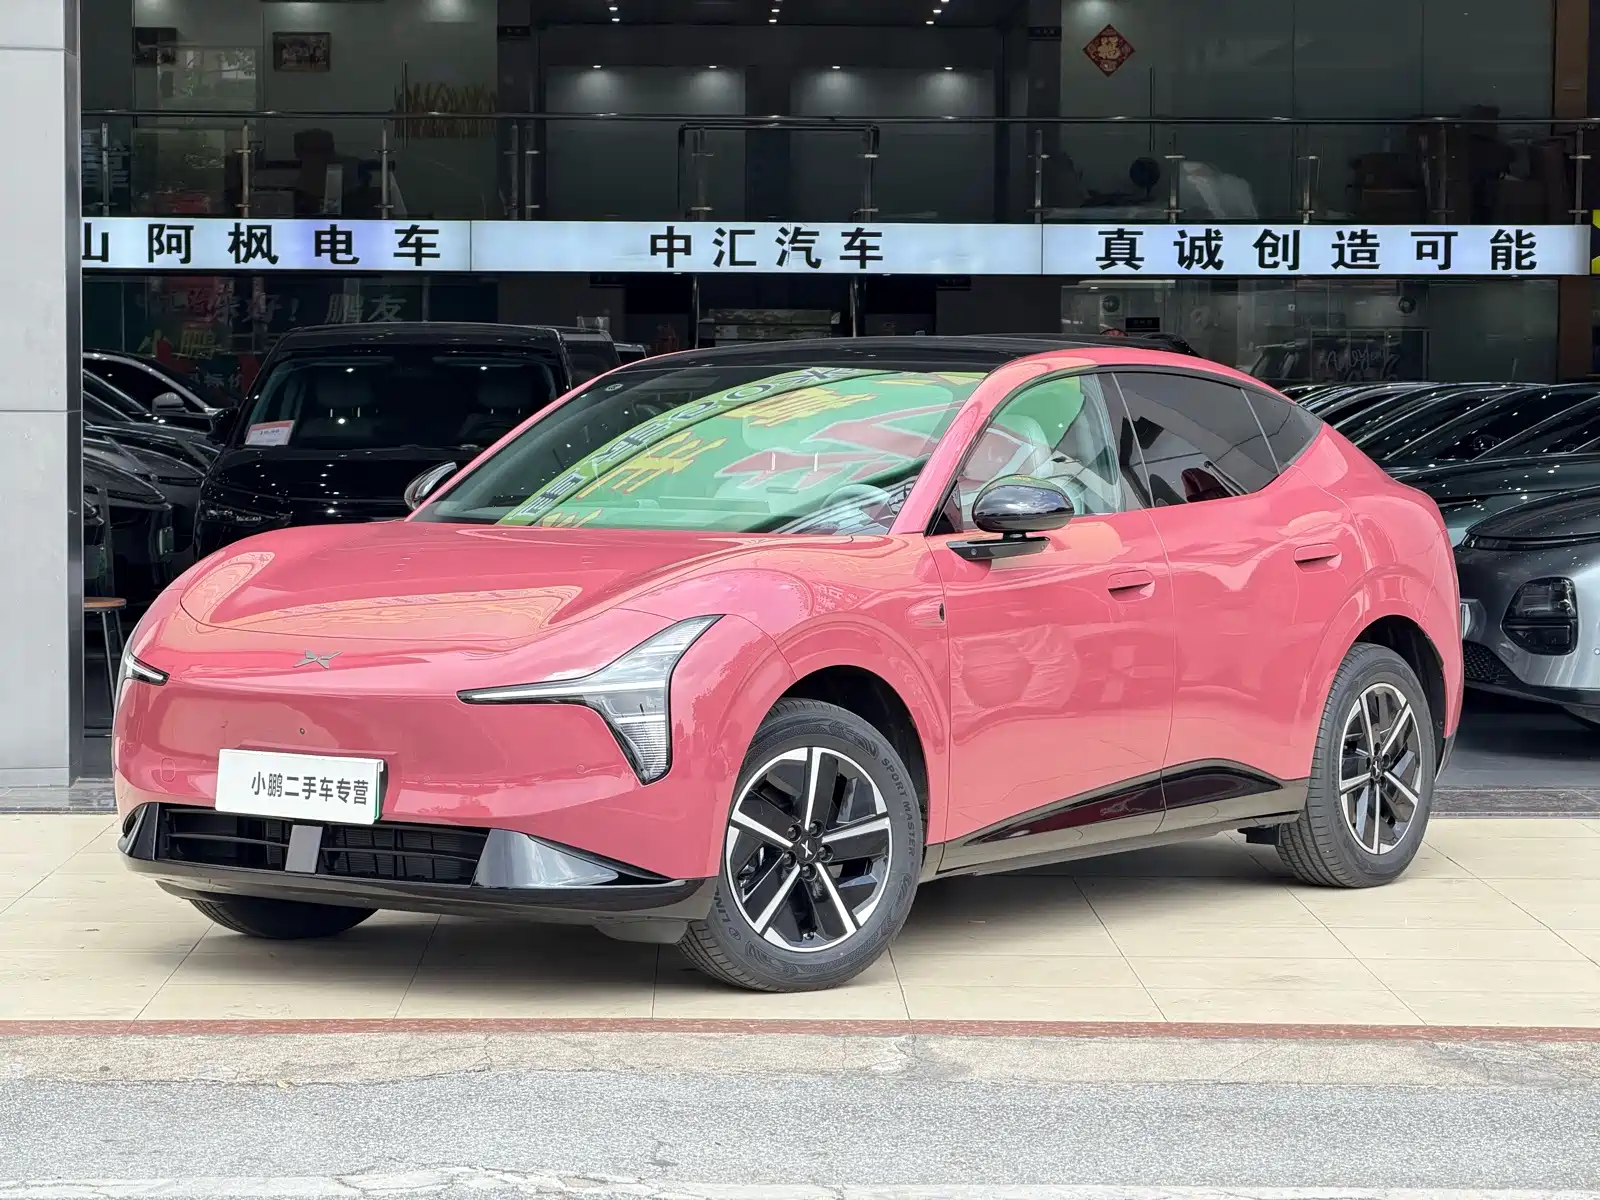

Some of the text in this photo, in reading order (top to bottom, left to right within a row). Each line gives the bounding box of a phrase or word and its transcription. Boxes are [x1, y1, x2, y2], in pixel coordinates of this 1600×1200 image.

[649, 225, 884, 269] 中汇汽车
[1095, 227, 1538, 271] 真诚创造可能
[251, 771, 369, 806] 小鹏二手车专营
[881, 758, 916, 857] SPORT MASTER
